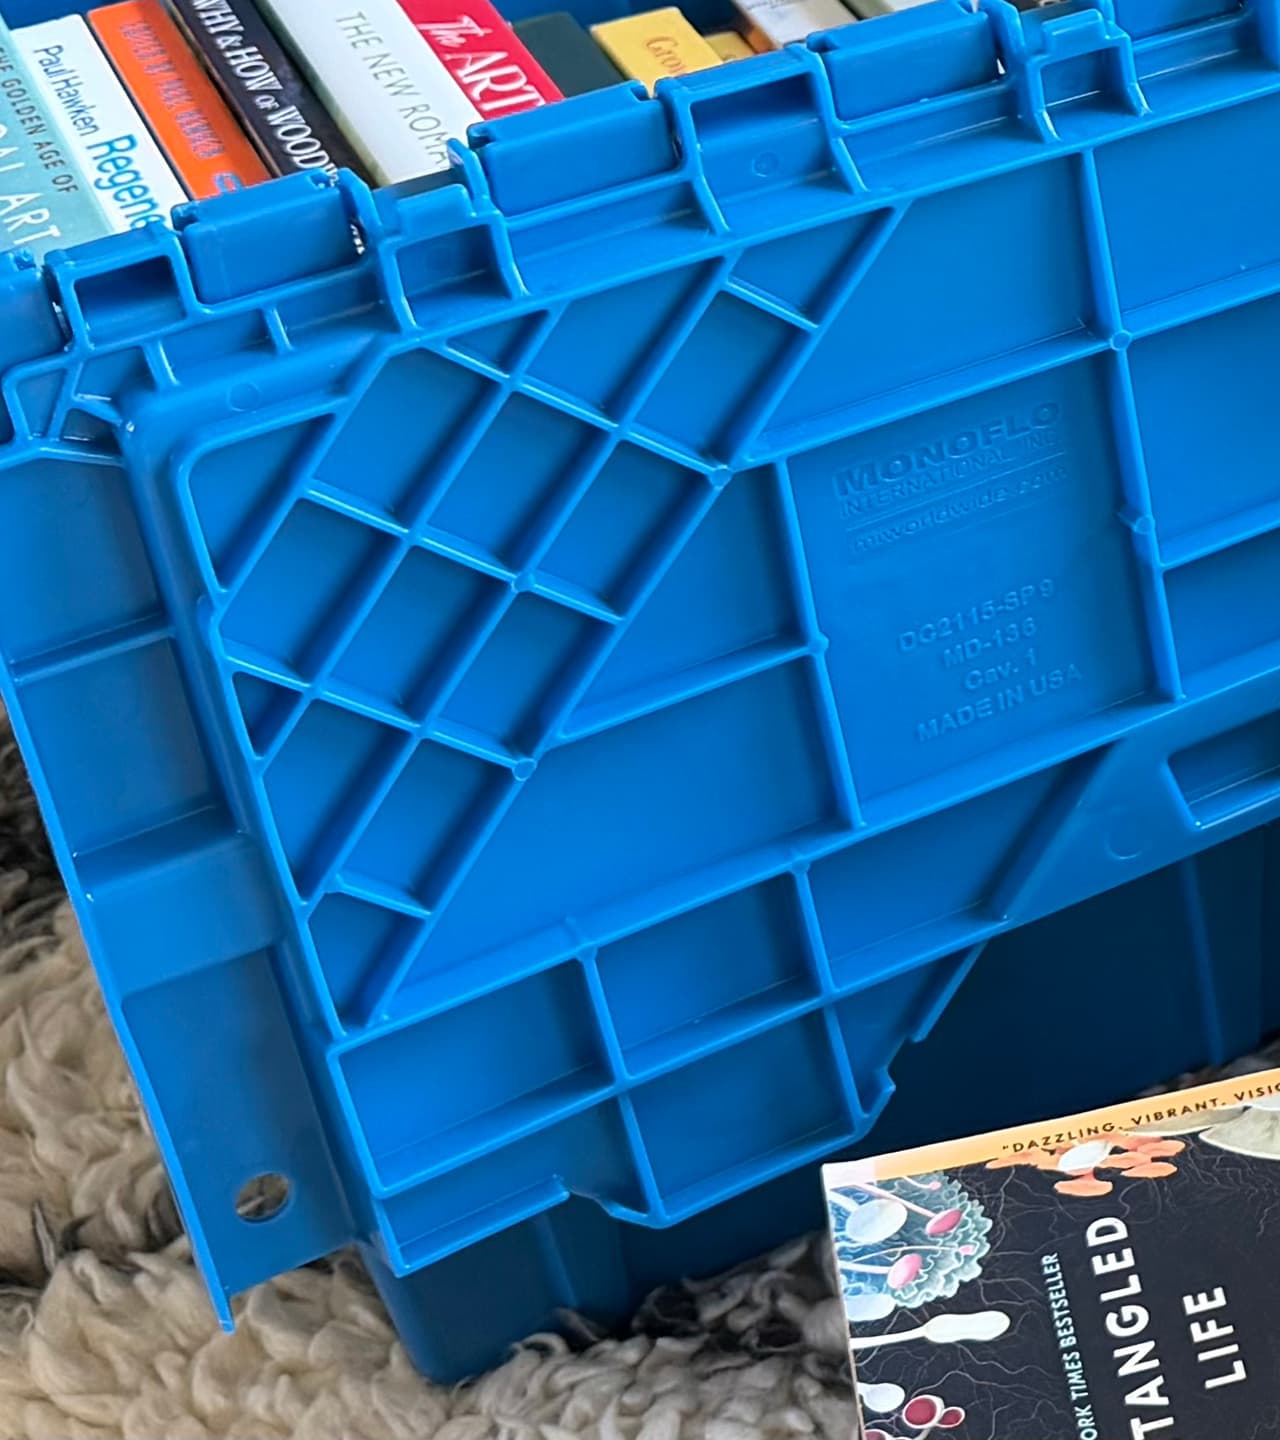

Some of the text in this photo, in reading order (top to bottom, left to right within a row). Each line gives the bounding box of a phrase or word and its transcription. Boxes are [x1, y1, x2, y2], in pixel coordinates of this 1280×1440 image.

[215, 34, 243, 49] &
[223, 46, 283, 91] HOW
[335, 11, 383, 50] THE
[361, 51, 423, 98] NEW
[417, 14, 549, 111] The ART
[33, 44, 101, 137] Paul Hawken
[254, 94, 280, 111] OF
[2, 78, 46, 136] GOLDEN
[33, 140, 66, 170] AGE
[52, 174, 78, 194] OF
[0, 192, 61, 245] ART
[831, 401, 1060, 497] MONOFLO
[941, 616, 1038, 668] MD-136
[963, 660, 1020, 691] Cav.
[915, 663, 1083, 743] MADE IN USA
[1131, 1097, 1227, 1128] VIBRANT,
[1041, 1252, 1077, 1349] BESTSELLER
[1085, 1216, 1175, 1440] TANGLED
[1183, 1286, 1247, 1389] LIFE
[1062, 1350, 1089, 1401] TIMES
